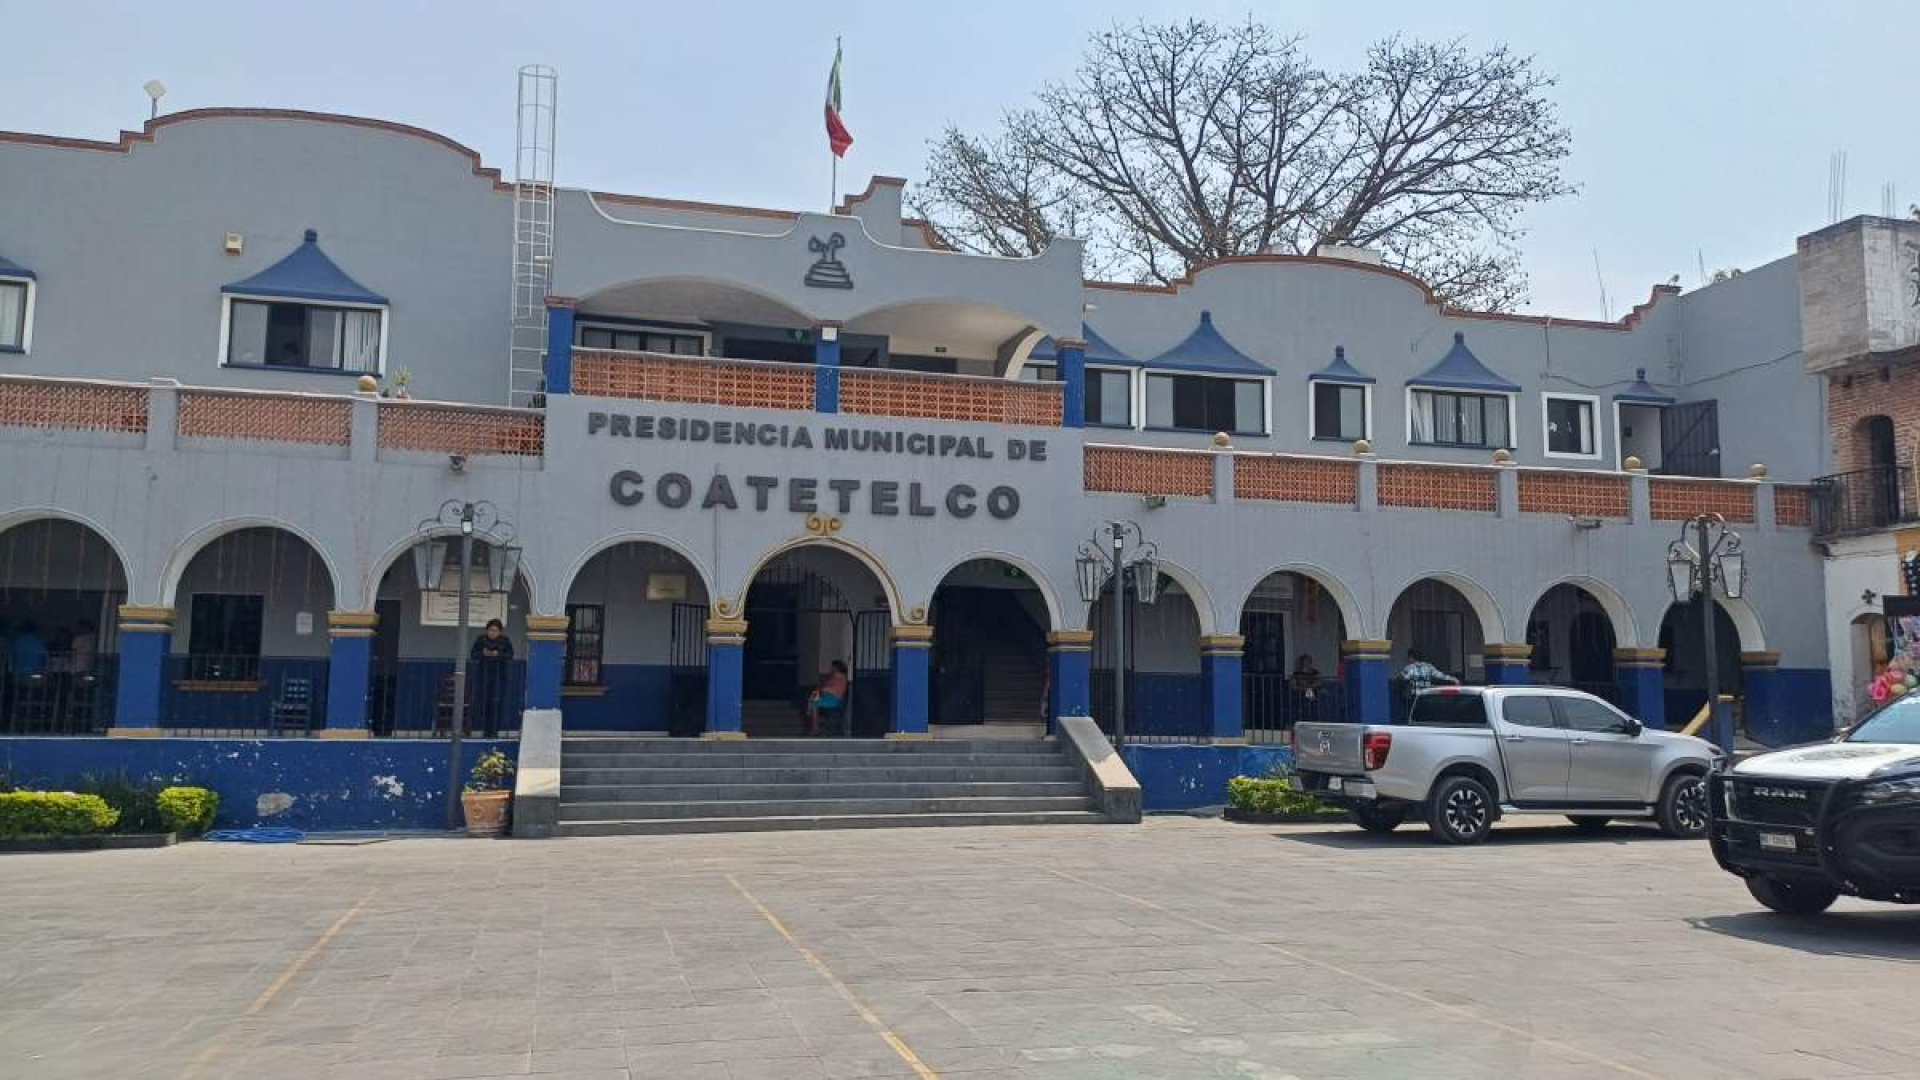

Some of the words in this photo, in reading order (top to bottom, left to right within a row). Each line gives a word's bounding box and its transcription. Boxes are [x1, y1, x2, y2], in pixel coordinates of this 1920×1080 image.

[588, 412, 813, 449] PRESIDENCIA
[824, 428, 994, 459] MUNICIPAL
[1007, 439, 1047, 461] DE
[610, 469, 1020, 520] COATETELCO
